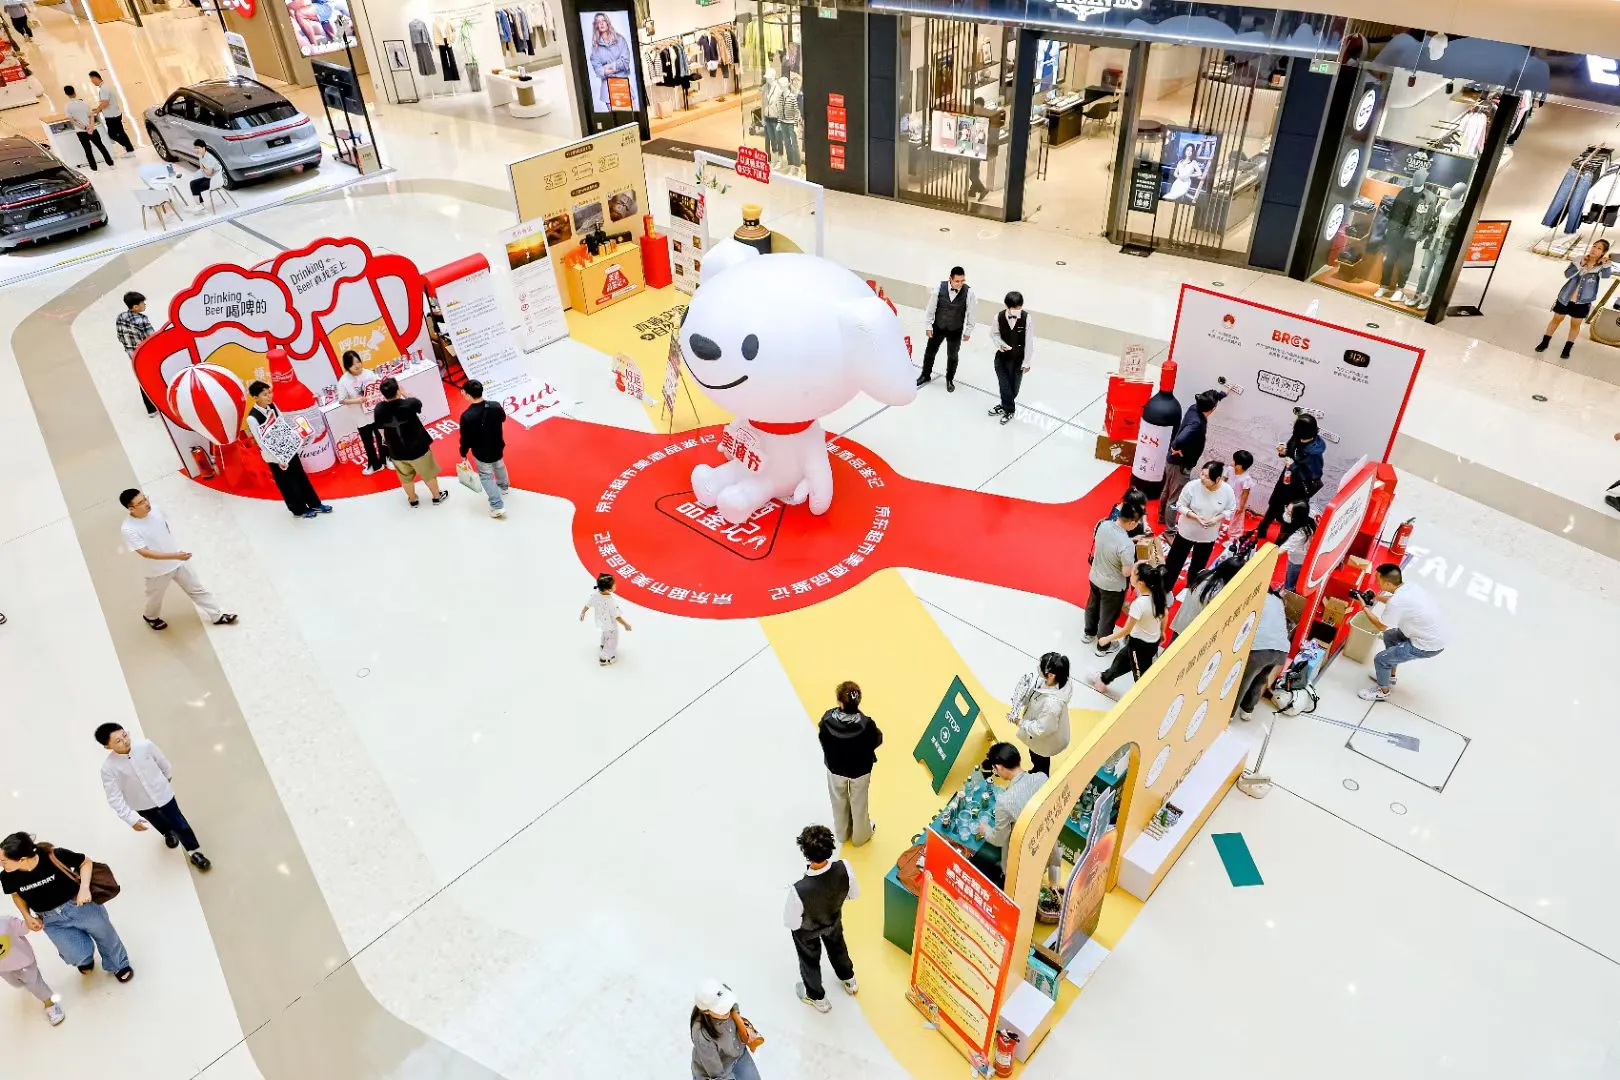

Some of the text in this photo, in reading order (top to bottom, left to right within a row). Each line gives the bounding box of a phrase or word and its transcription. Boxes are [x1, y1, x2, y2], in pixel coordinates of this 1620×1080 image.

[290, 258, 325, 286] Drinking
[203, 291, 242, 305] Drinking
[297, 280, 315, 295] Beer
[205, 299, 267, 318] Beer 喝啤的
[503, 382, 558, 416] Bud
[595, 433, 718, 514] 京东超市美酒品鉴记
[768, 505, 891, 601] 京东超市美酒品鉴记
[593, 530, 734, 606] 京东超市美酒品鉴记
[944, 710, 961, 733] STOP
